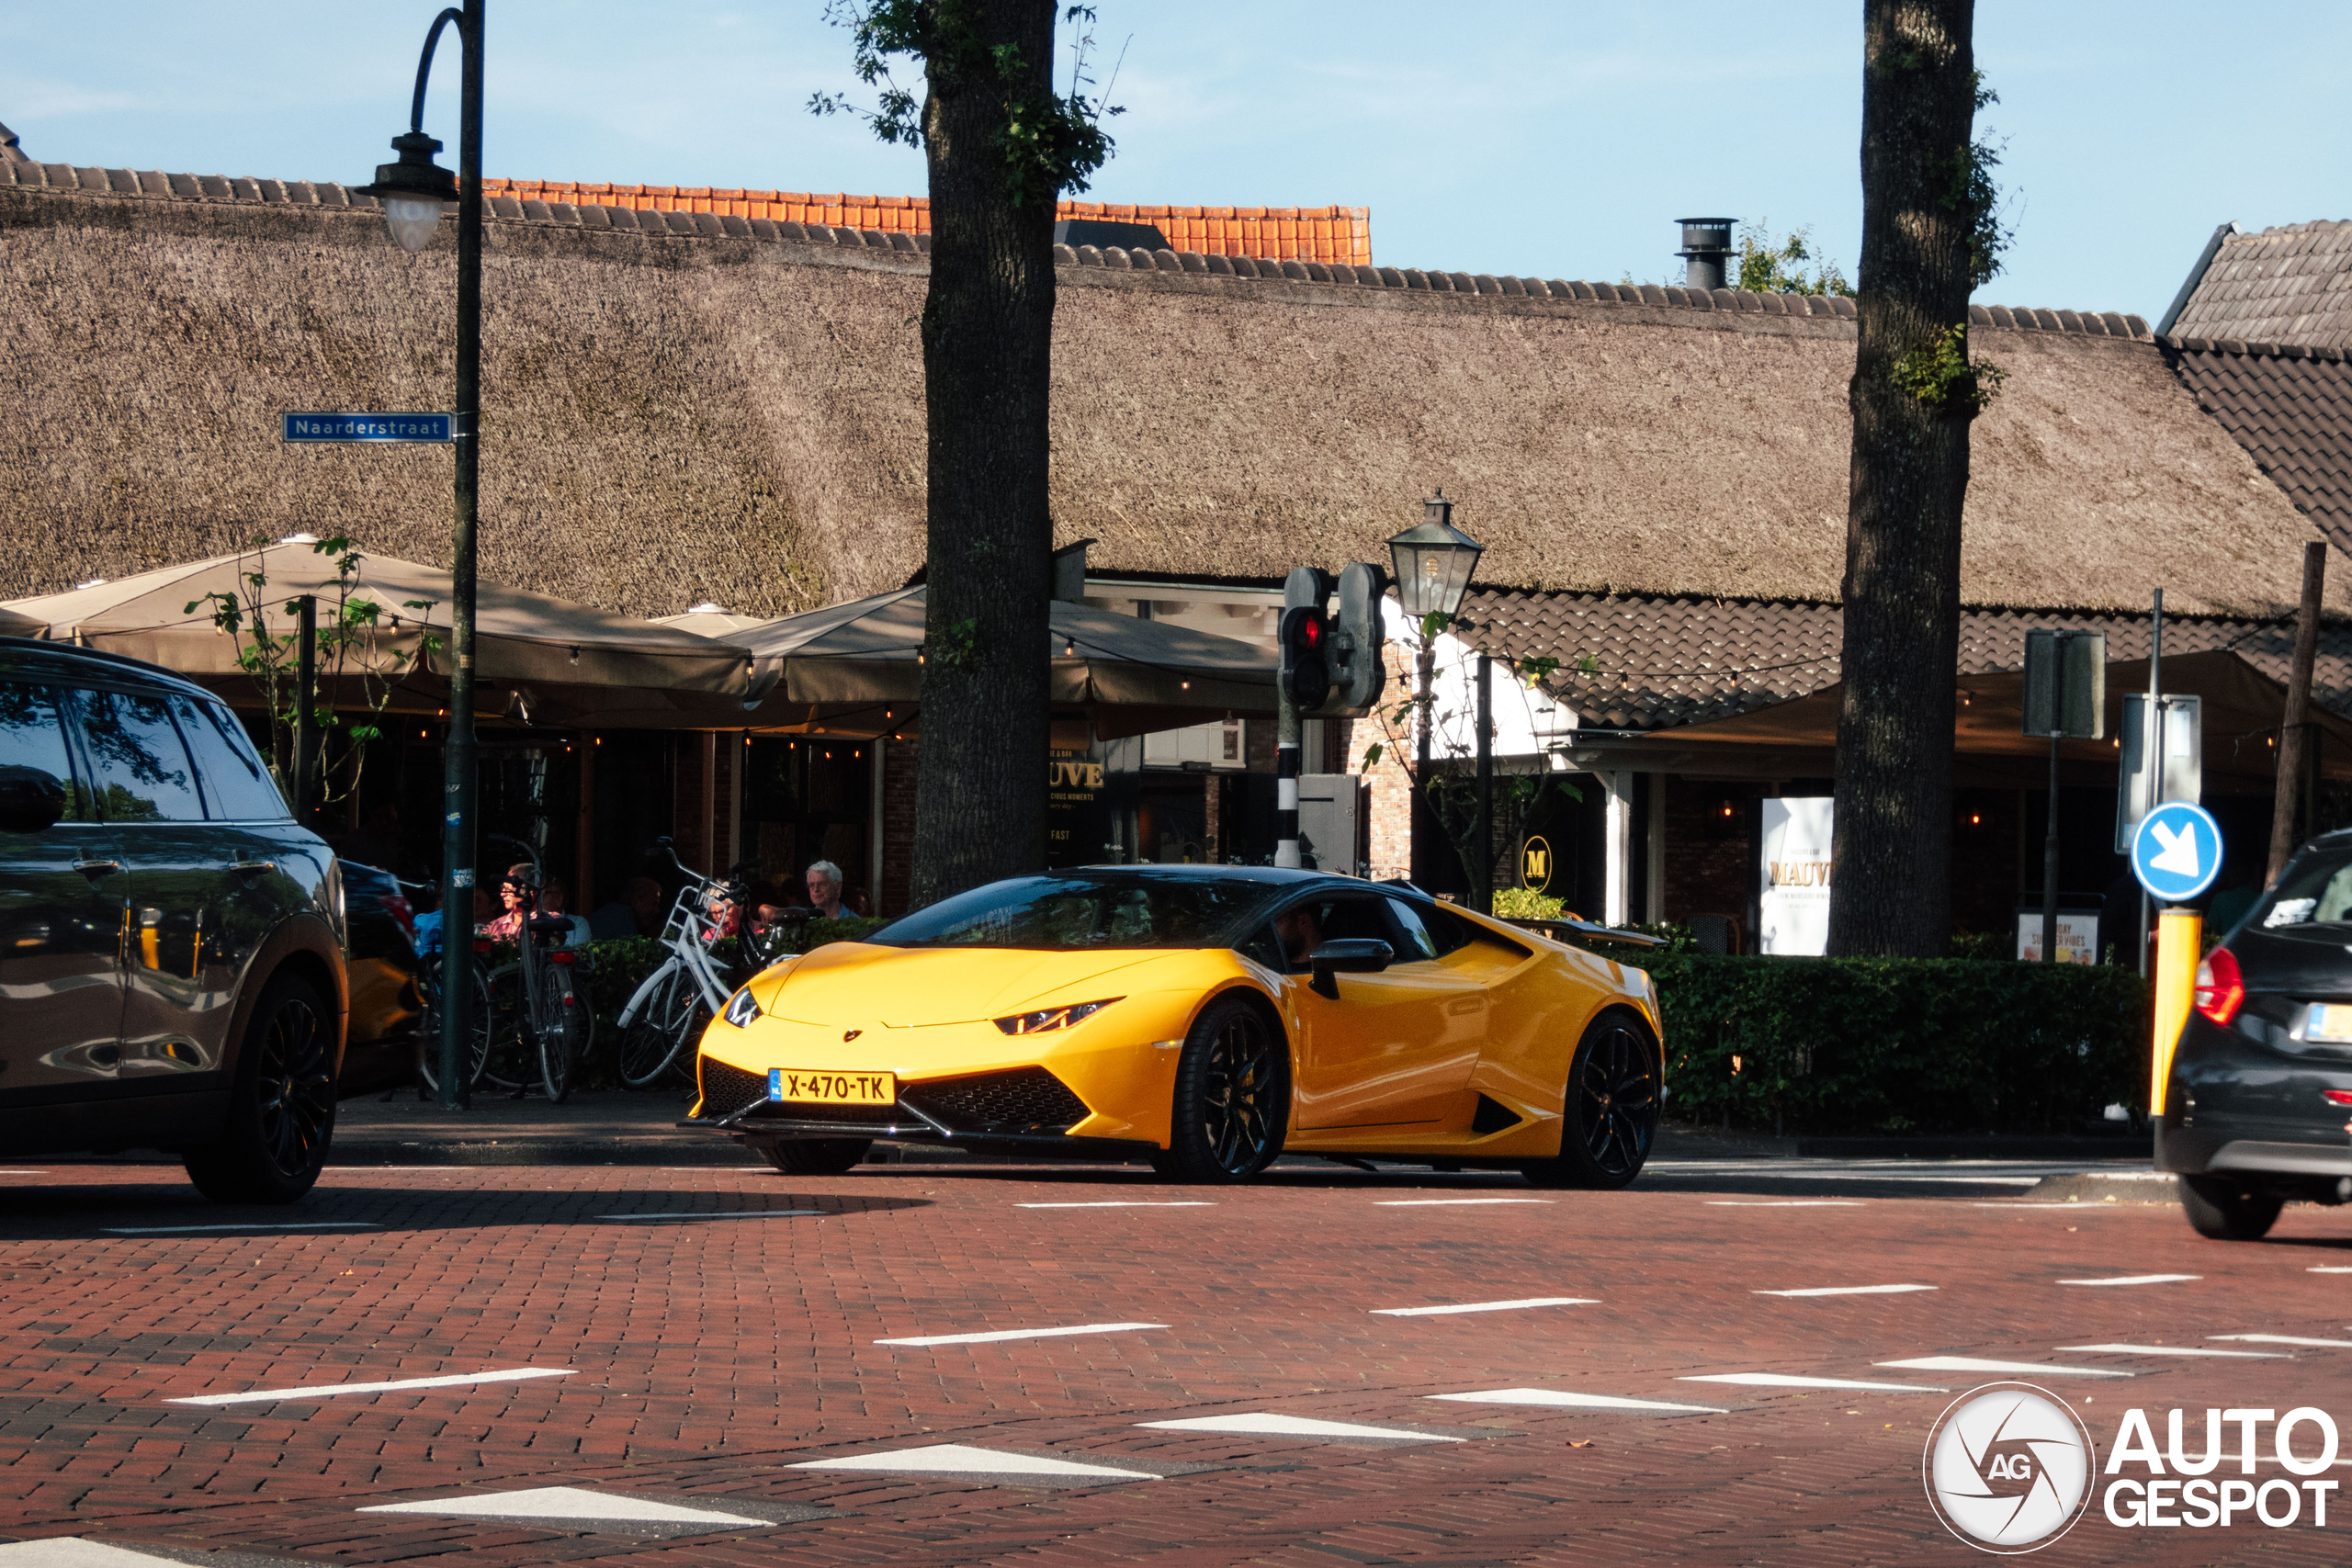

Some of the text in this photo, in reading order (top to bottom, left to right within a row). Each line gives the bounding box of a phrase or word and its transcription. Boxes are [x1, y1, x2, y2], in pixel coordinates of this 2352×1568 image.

[296, 420, 439, 434] Naarderstraat
[1061, 750, 1072, 758] BAR
[1068, 793, 1094, 801] MOMENTS
[1051, 829, 1070, 840] FAST
[1526, 850, 1545, 878] M
[1770, 862, 1831, 886] MAUV
[2064, 934, 2086, 946] VIBES
[772, 1087, 781, 1095] NL
[788, 1075, 885, 1100] X-470-TK
